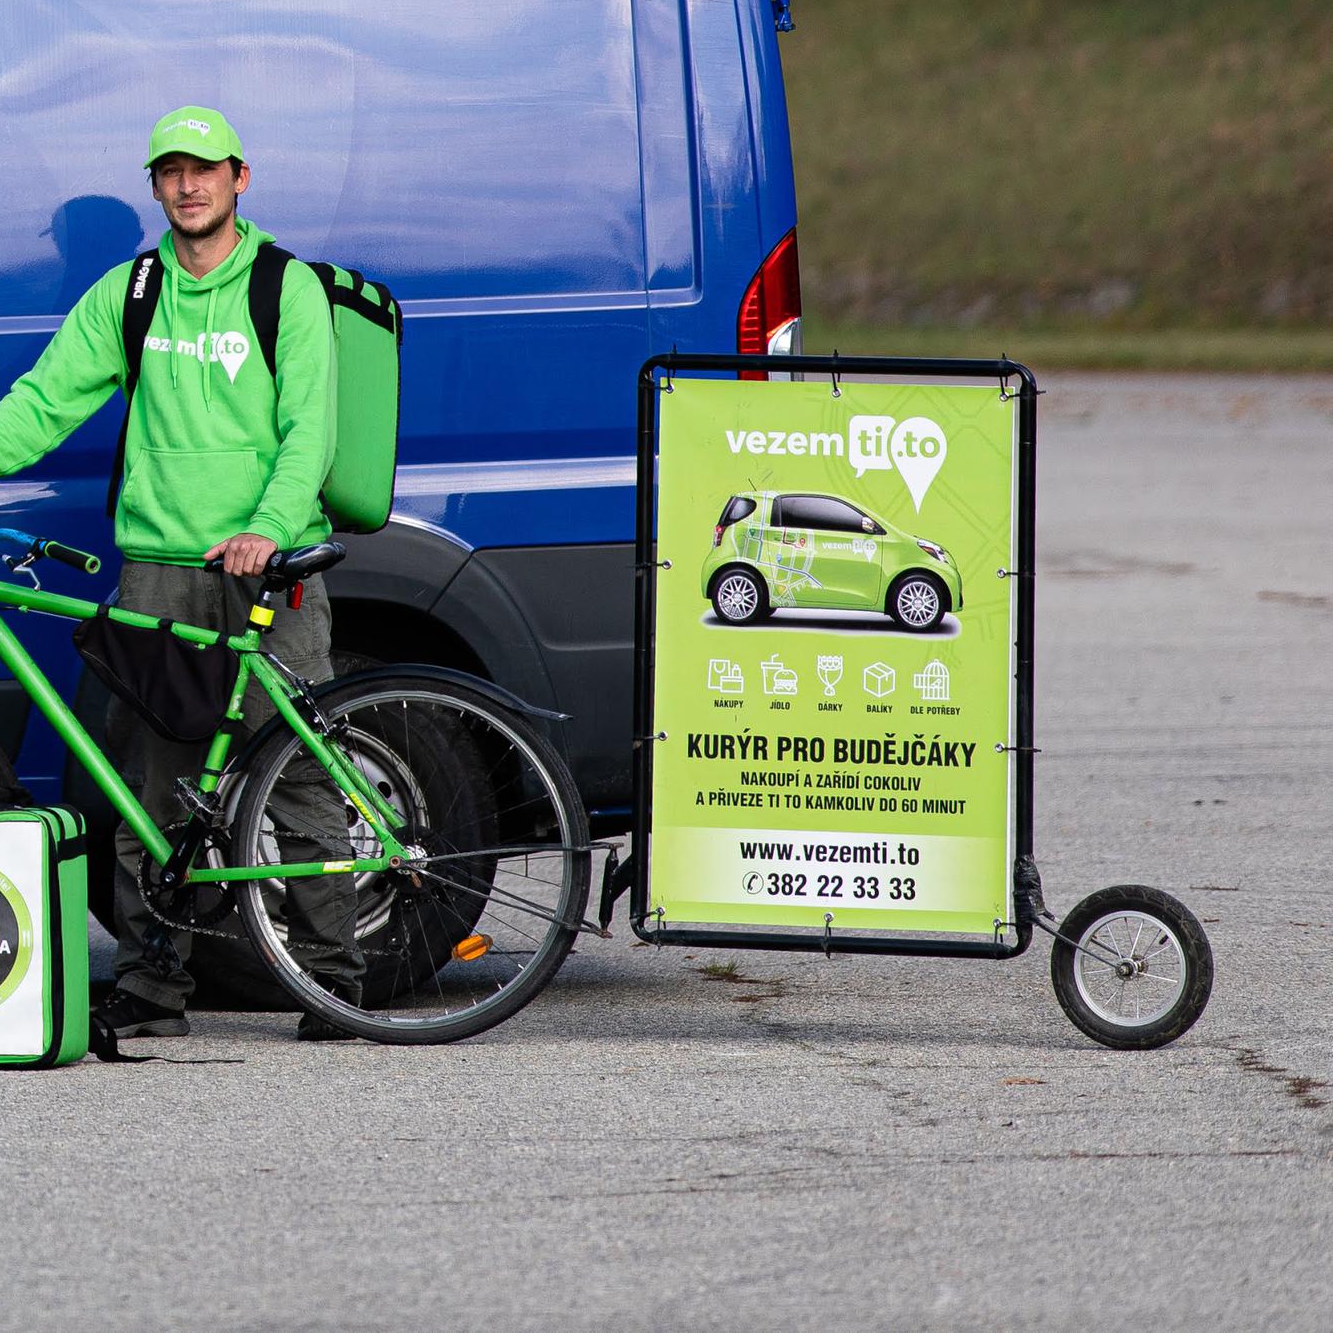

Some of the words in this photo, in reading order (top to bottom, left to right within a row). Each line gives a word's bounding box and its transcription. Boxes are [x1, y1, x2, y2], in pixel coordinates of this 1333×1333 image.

[725, 428, 844, 457] vezem
[714, 698, 744, 710] NÁKUPY
[769, 700, 791, 711] JÍDLO
[818, 701, 843, 712] DÁRKY
[866, 703, 893, 715] BALÍKY
[910, 706, 924, 715] DLE
[926, 704, 961, 716] POTŘEBY
[687, 727, 768, 761] KURÝR
[777, 736, 825, 762] PRO
[833, 733, 977, 768] BUDĚJČÁKY
[741, 769, 801, 788] NAKOUPÍ
[803, 773, 813, 788] A
[816, 770, 860, 790] ZAŘÍDÍ
[864, 775, 921, 791] COKOLIV
[696, 792, 705, 806] A
[708, 788, 764, 808] PŘIVEZE
[767, 793, 782, 808] TI
[784, 794, 802, 809] TO
[805, 794, 875, 812] KAMKOLIV
[879, 798, 898, 813] DO
[901, 798, 918, 813] 60
[922, 798, 967, 815] MINUT
[740, 840, 920, 866] www.vezemti.to
[767, 872, 807, 898] 382
[817, 874, 844, 899] 22
[853, 875, 880, 900] 33
[889, 877, 916, 901] 33
